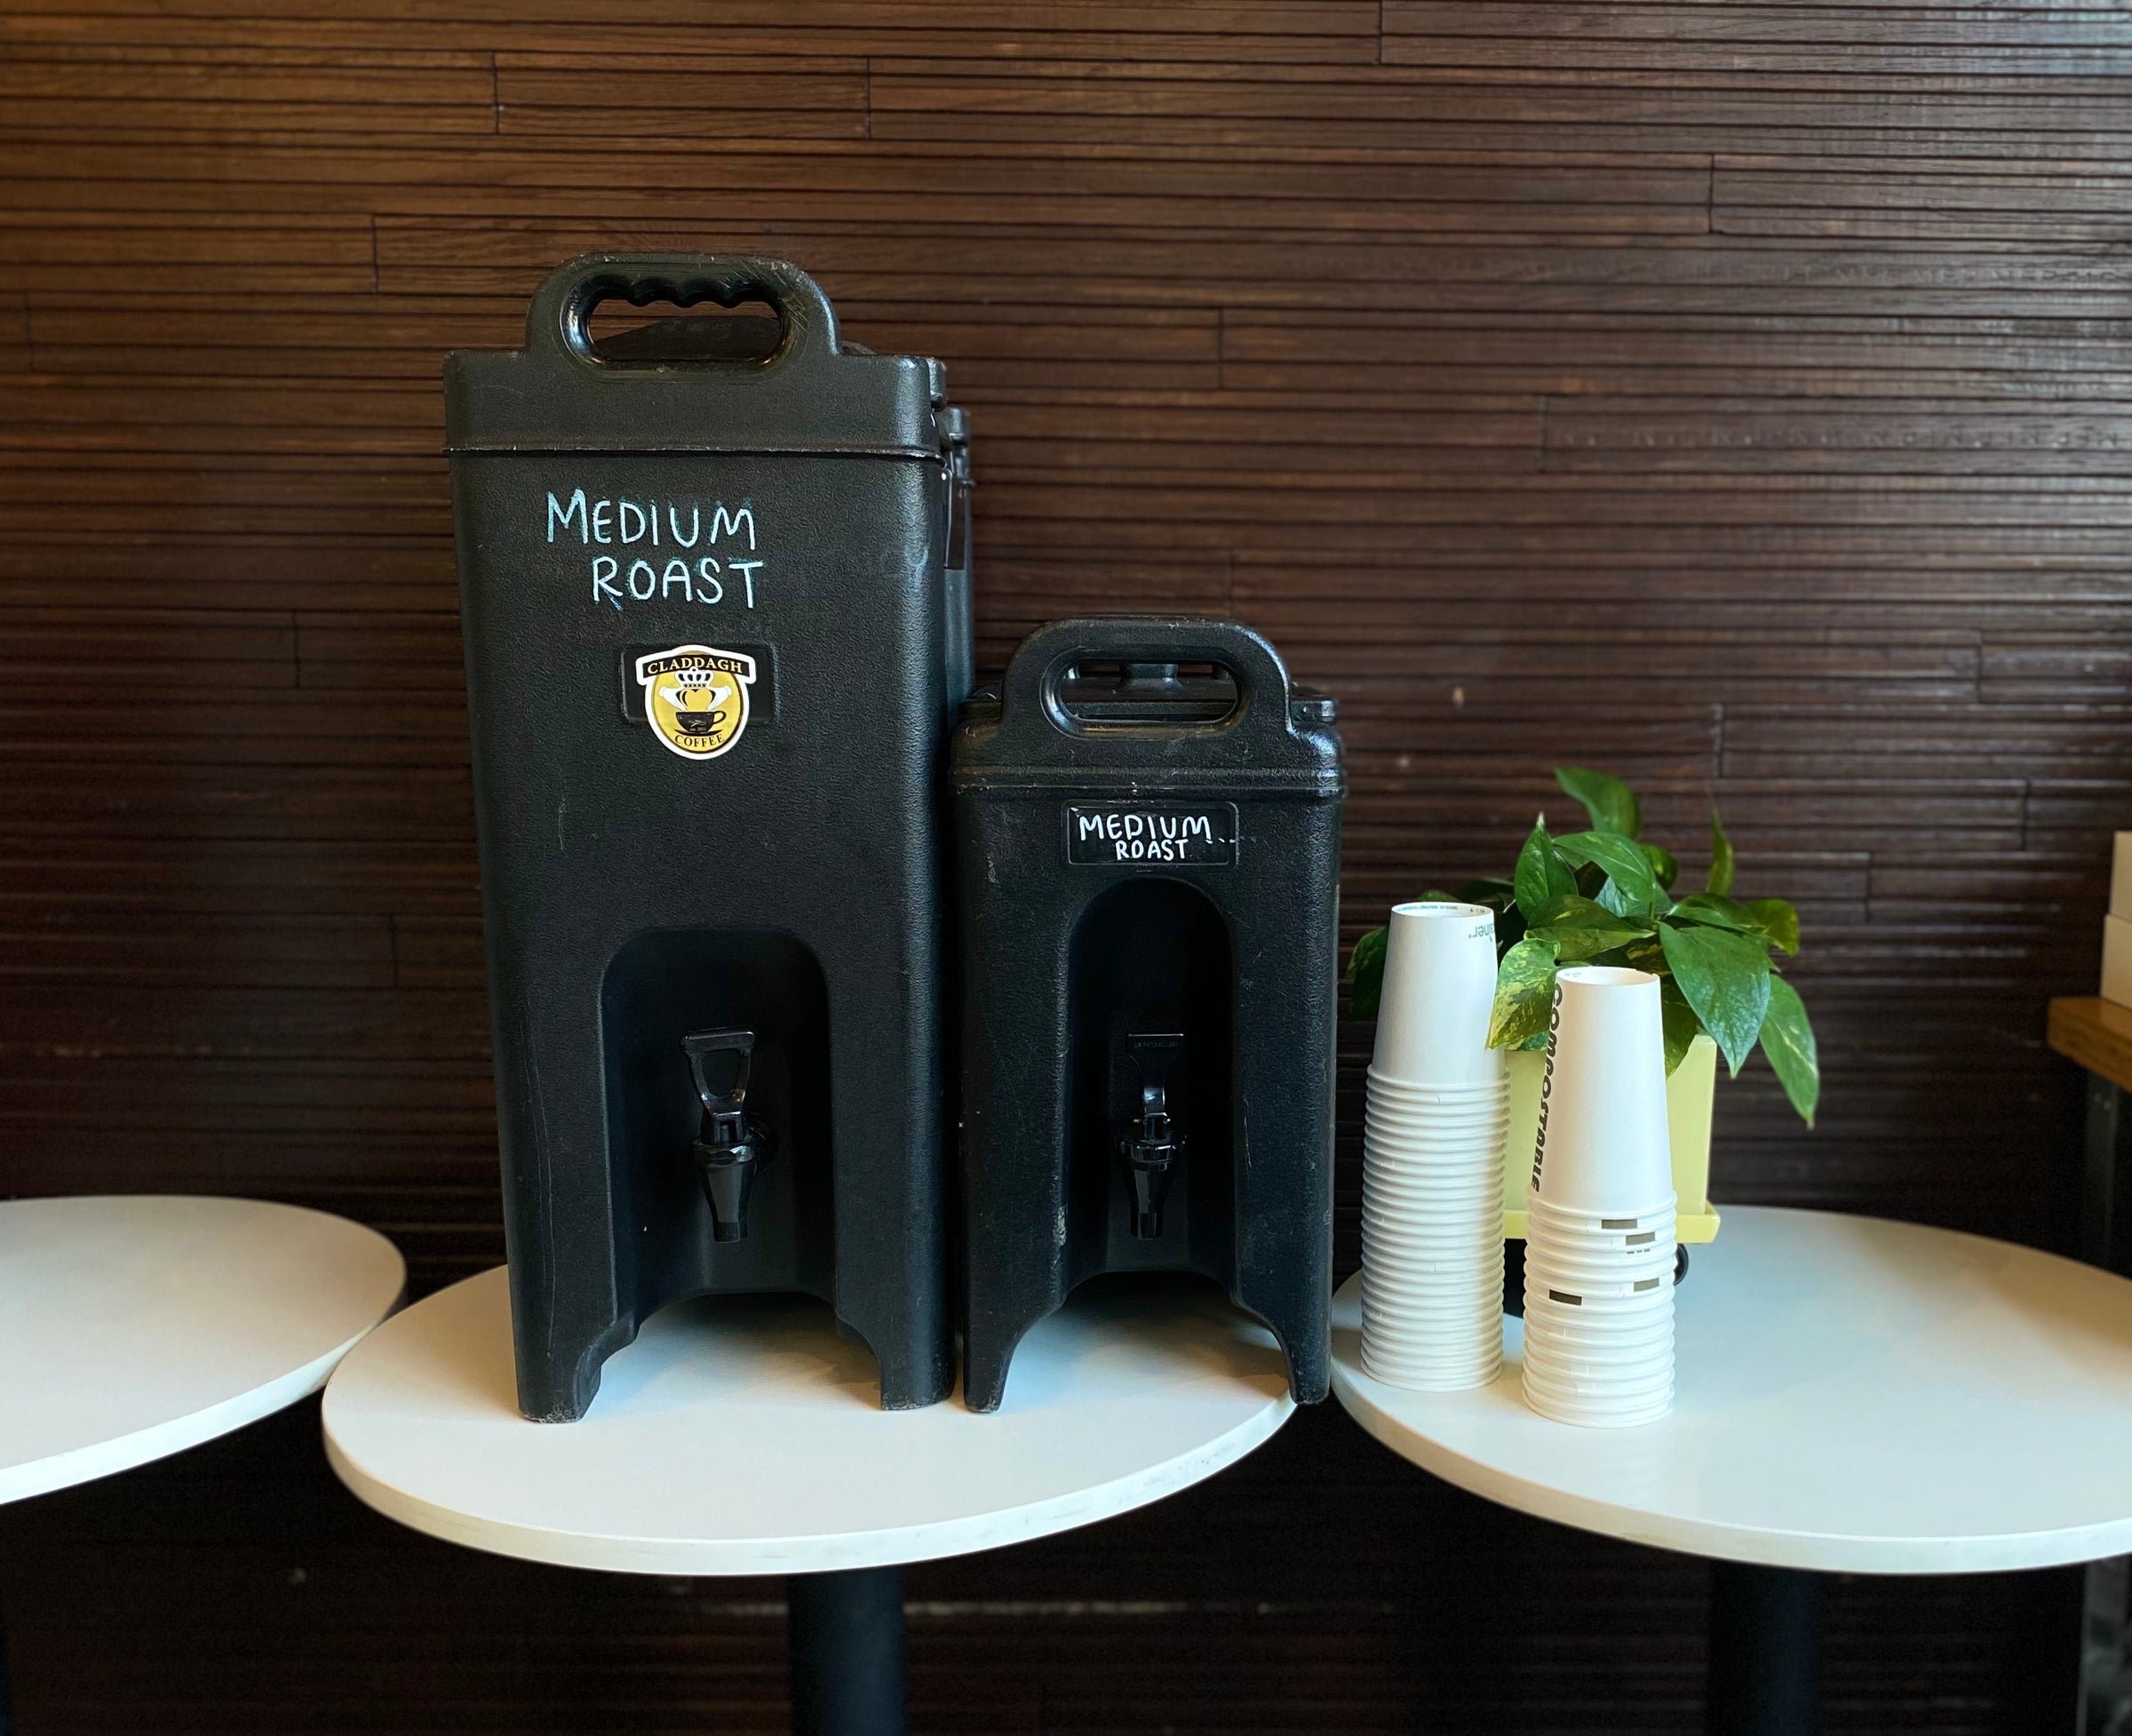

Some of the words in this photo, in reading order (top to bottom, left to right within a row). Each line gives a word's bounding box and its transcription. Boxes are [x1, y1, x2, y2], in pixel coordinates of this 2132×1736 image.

[546, 488, 756, 550] MEDIUM
[592, 556, 764, 609] ROAST
[647, 657, 743, 674] CLADDAGH
[674, 733, 725, 747] COFFEE
[1078, 814, 1213, 841] MEDIUM
[1115, 839, 1189, 861] ROAST
[1531, 982, 1563, 1193] COMPOSTABLE
